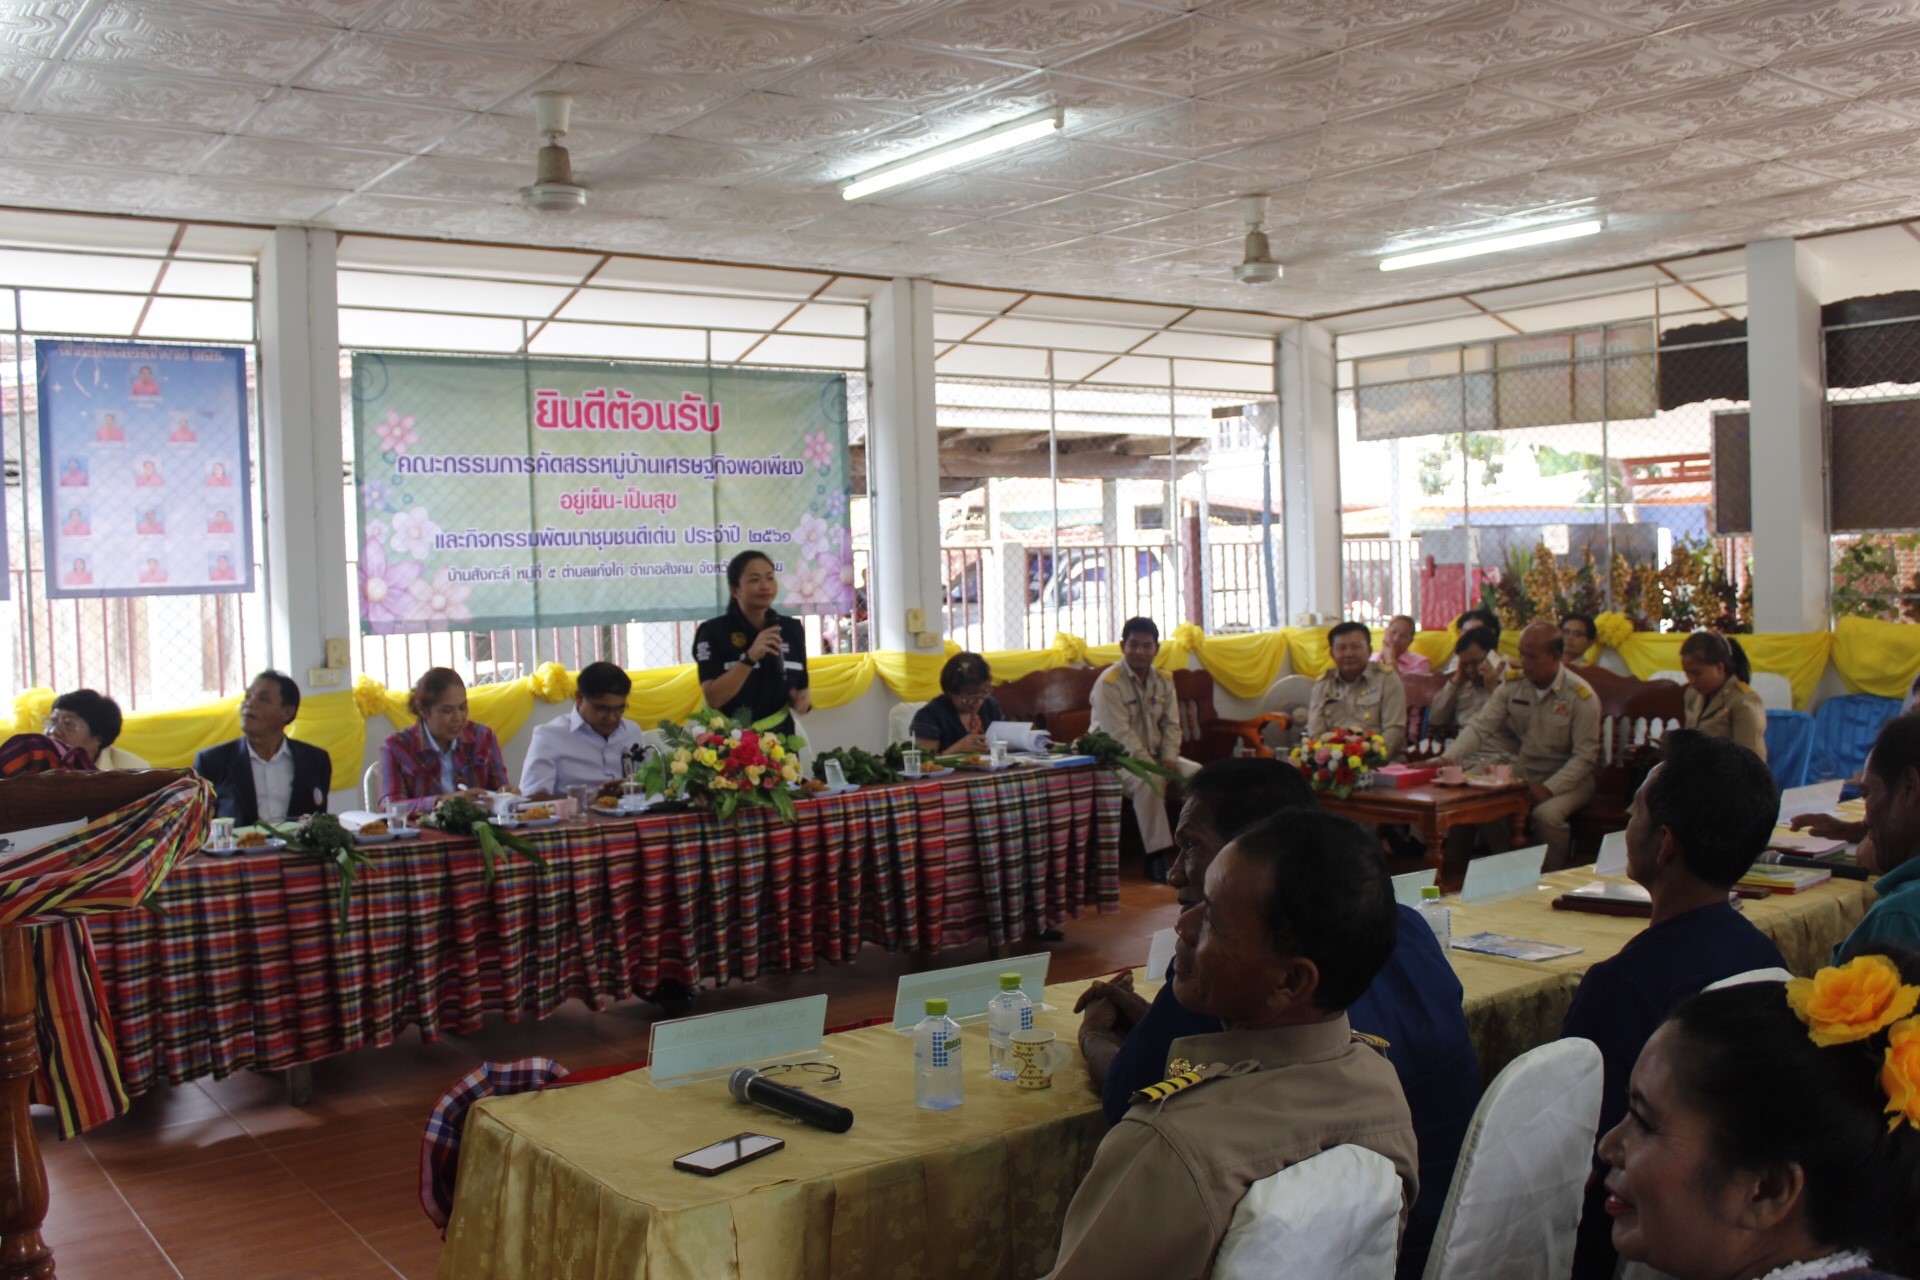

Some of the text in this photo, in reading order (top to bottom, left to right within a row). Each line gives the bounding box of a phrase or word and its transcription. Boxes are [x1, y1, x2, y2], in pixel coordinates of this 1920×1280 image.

[536, 389, 721, 432] ยินดีต้อนรับ
[397, 452, 804, 480] คณะกรรมการคัดสรรหมู่บ้านเศรษฐกิจพอเพียง
[560, 487, 677, 514] อยู่เย็น-เป็นสุข
[435, 525, 792, 550] และกิจกรรมพัฒนาชุมชนดีเด่น ประจำปี ๒๕๖๑
